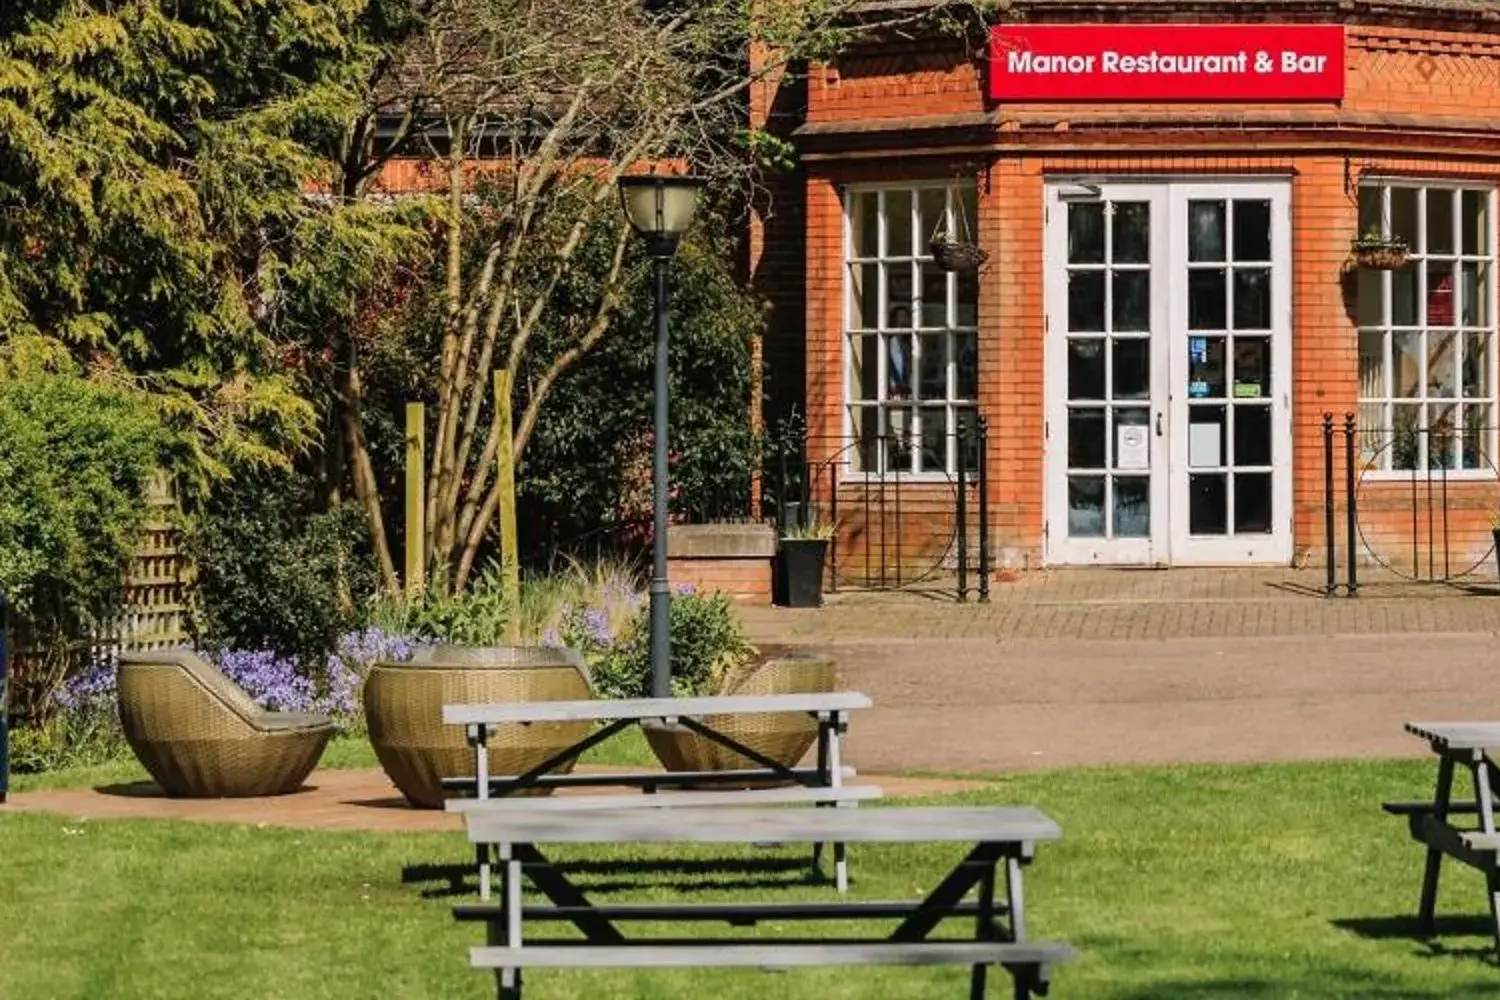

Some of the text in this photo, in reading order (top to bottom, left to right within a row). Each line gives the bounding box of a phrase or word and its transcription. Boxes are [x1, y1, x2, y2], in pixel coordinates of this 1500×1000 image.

[1007, 51, 1327, 73] Manor Restaurant & Bar
